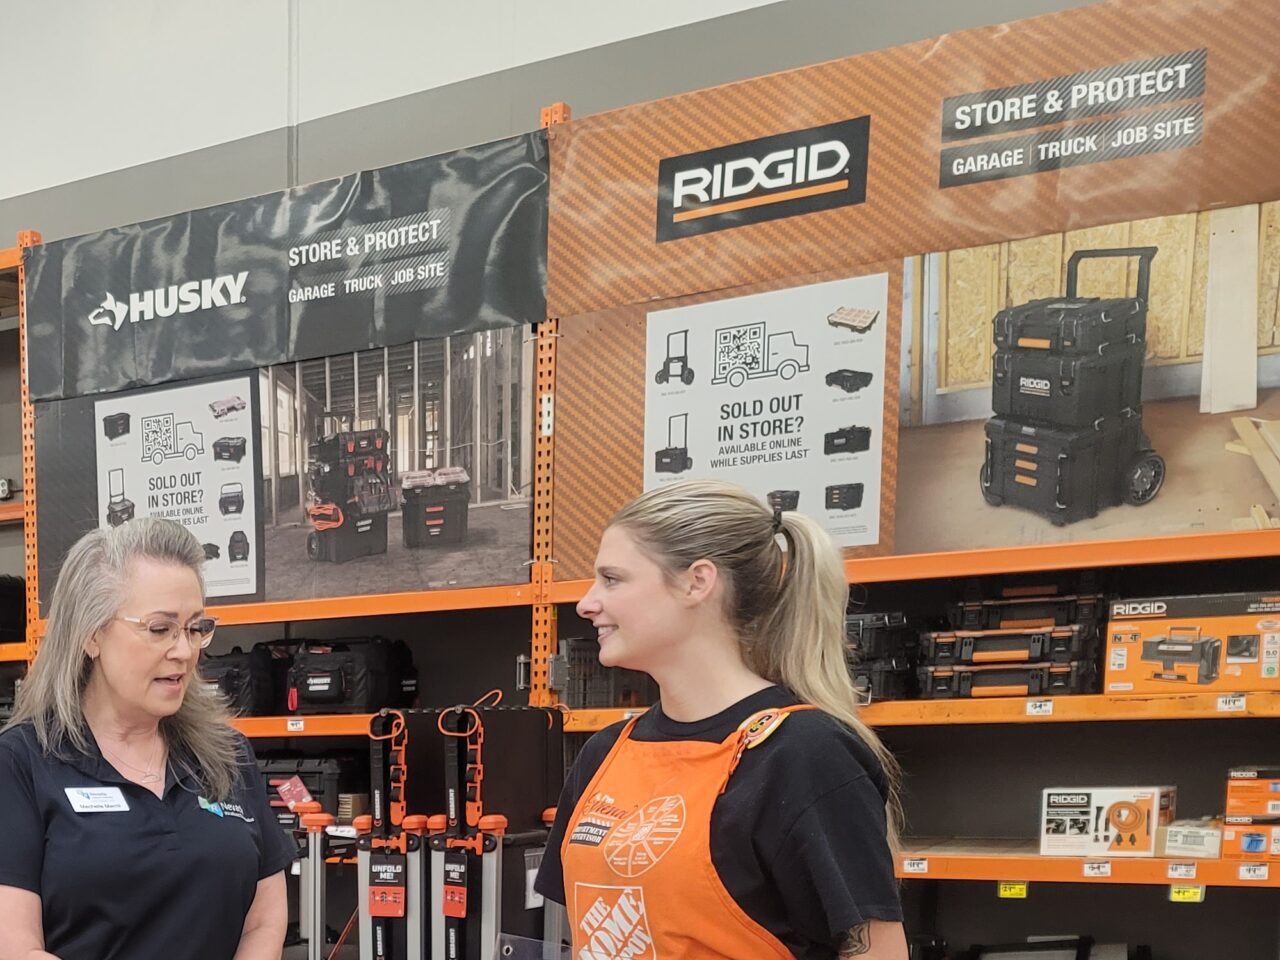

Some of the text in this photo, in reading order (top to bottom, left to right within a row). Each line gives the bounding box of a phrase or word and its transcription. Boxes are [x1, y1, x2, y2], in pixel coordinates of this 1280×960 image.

[955, 63, 1192, 130] STORE & PROTECT
[952, 116, 1196, 176] GARAGE TRUCK JOB SITE
[673, 140, 850, 208] RIDGID
[289, 219, 442, 267] STORE & PROTECT
[288, 263, 445, 304] GARAGE TRUCK JOB SITE
[129, 271, 249, 323] HUSKY
[1020, 376, 1050, 390] RIDGID
[720, 393, 804, 421] SOLD OUT
[718, 416, 805, 442] IN STORE?
[718, 437, 803, 456] AVAILABLE ONLINE
[710, 449, 808, 469] WHILE SUPPLIES LAST
[148, 472, 203, 491] SOLD OUT
[147, 490, 204, 509] IN STORE?
[182, 506, 204, 516] ONLINE
[193, 515, 208, 525] LAST
[1113, 601, 1167, 616] RIDGID
[1049, 794, 1088, 804] RIDGID
[372, 864, 402, 873] UNFOLD
[380, 872, 394, 880] ME!
[445, 863, 465, 873] UNFOLD
[580, 896, 611, 937] THE
